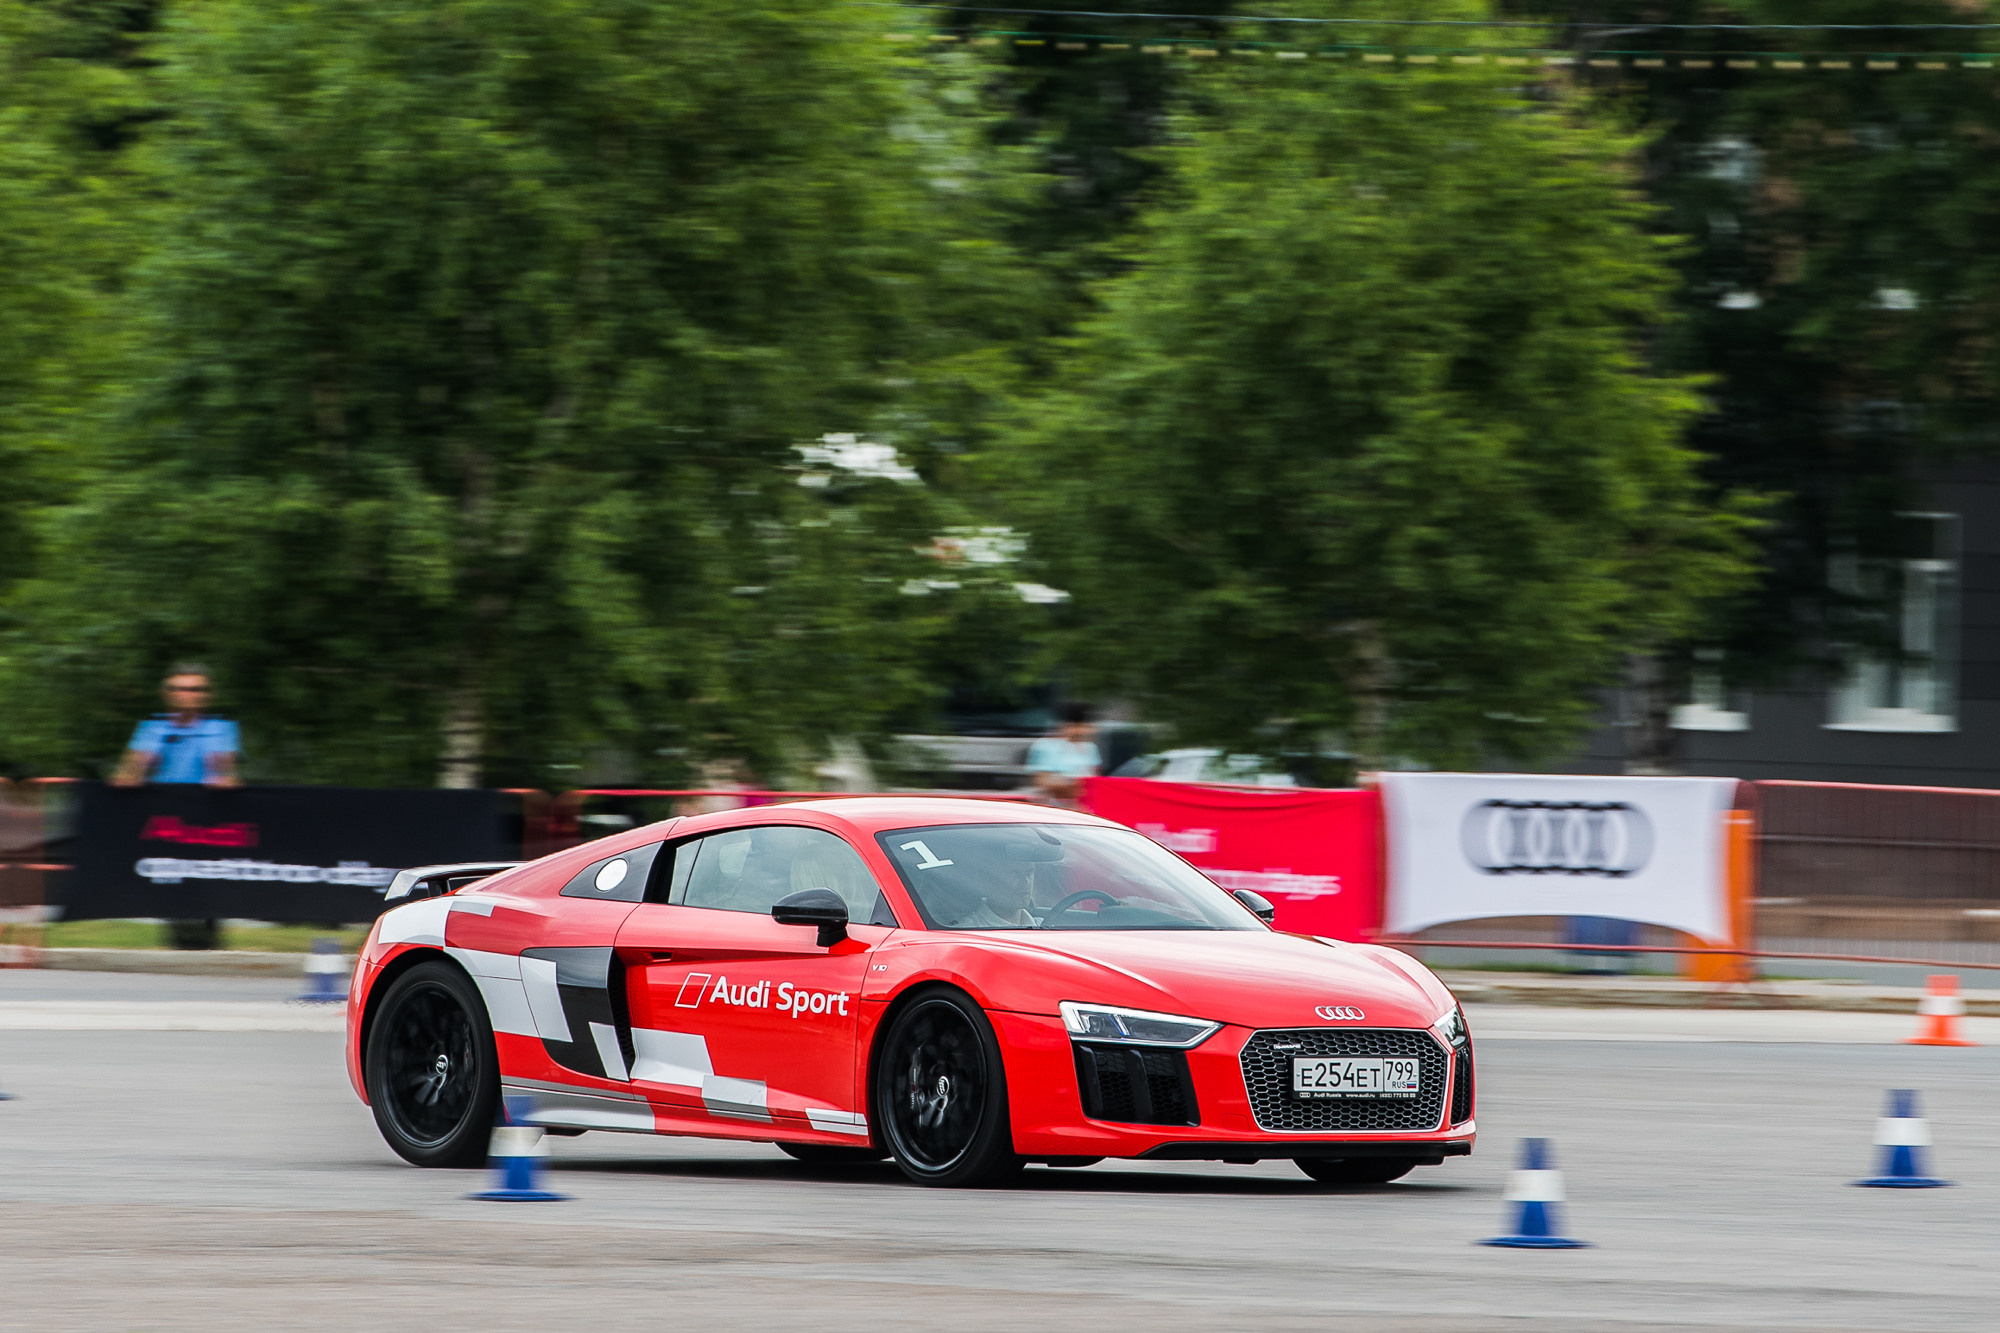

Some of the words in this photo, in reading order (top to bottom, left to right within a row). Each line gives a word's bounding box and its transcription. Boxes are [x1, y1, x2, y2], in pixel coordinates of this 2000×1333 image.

[900, 840, 954, 870] 1
[709, 976, 771, 1009] Audi
[775, 981, 849, 1019] Sport
[1300, 1062, 1381, 1088] E254ET
[1385, 1061, 1414, 1081] 799
[1391, 1081, 1406, 1089] RUS
